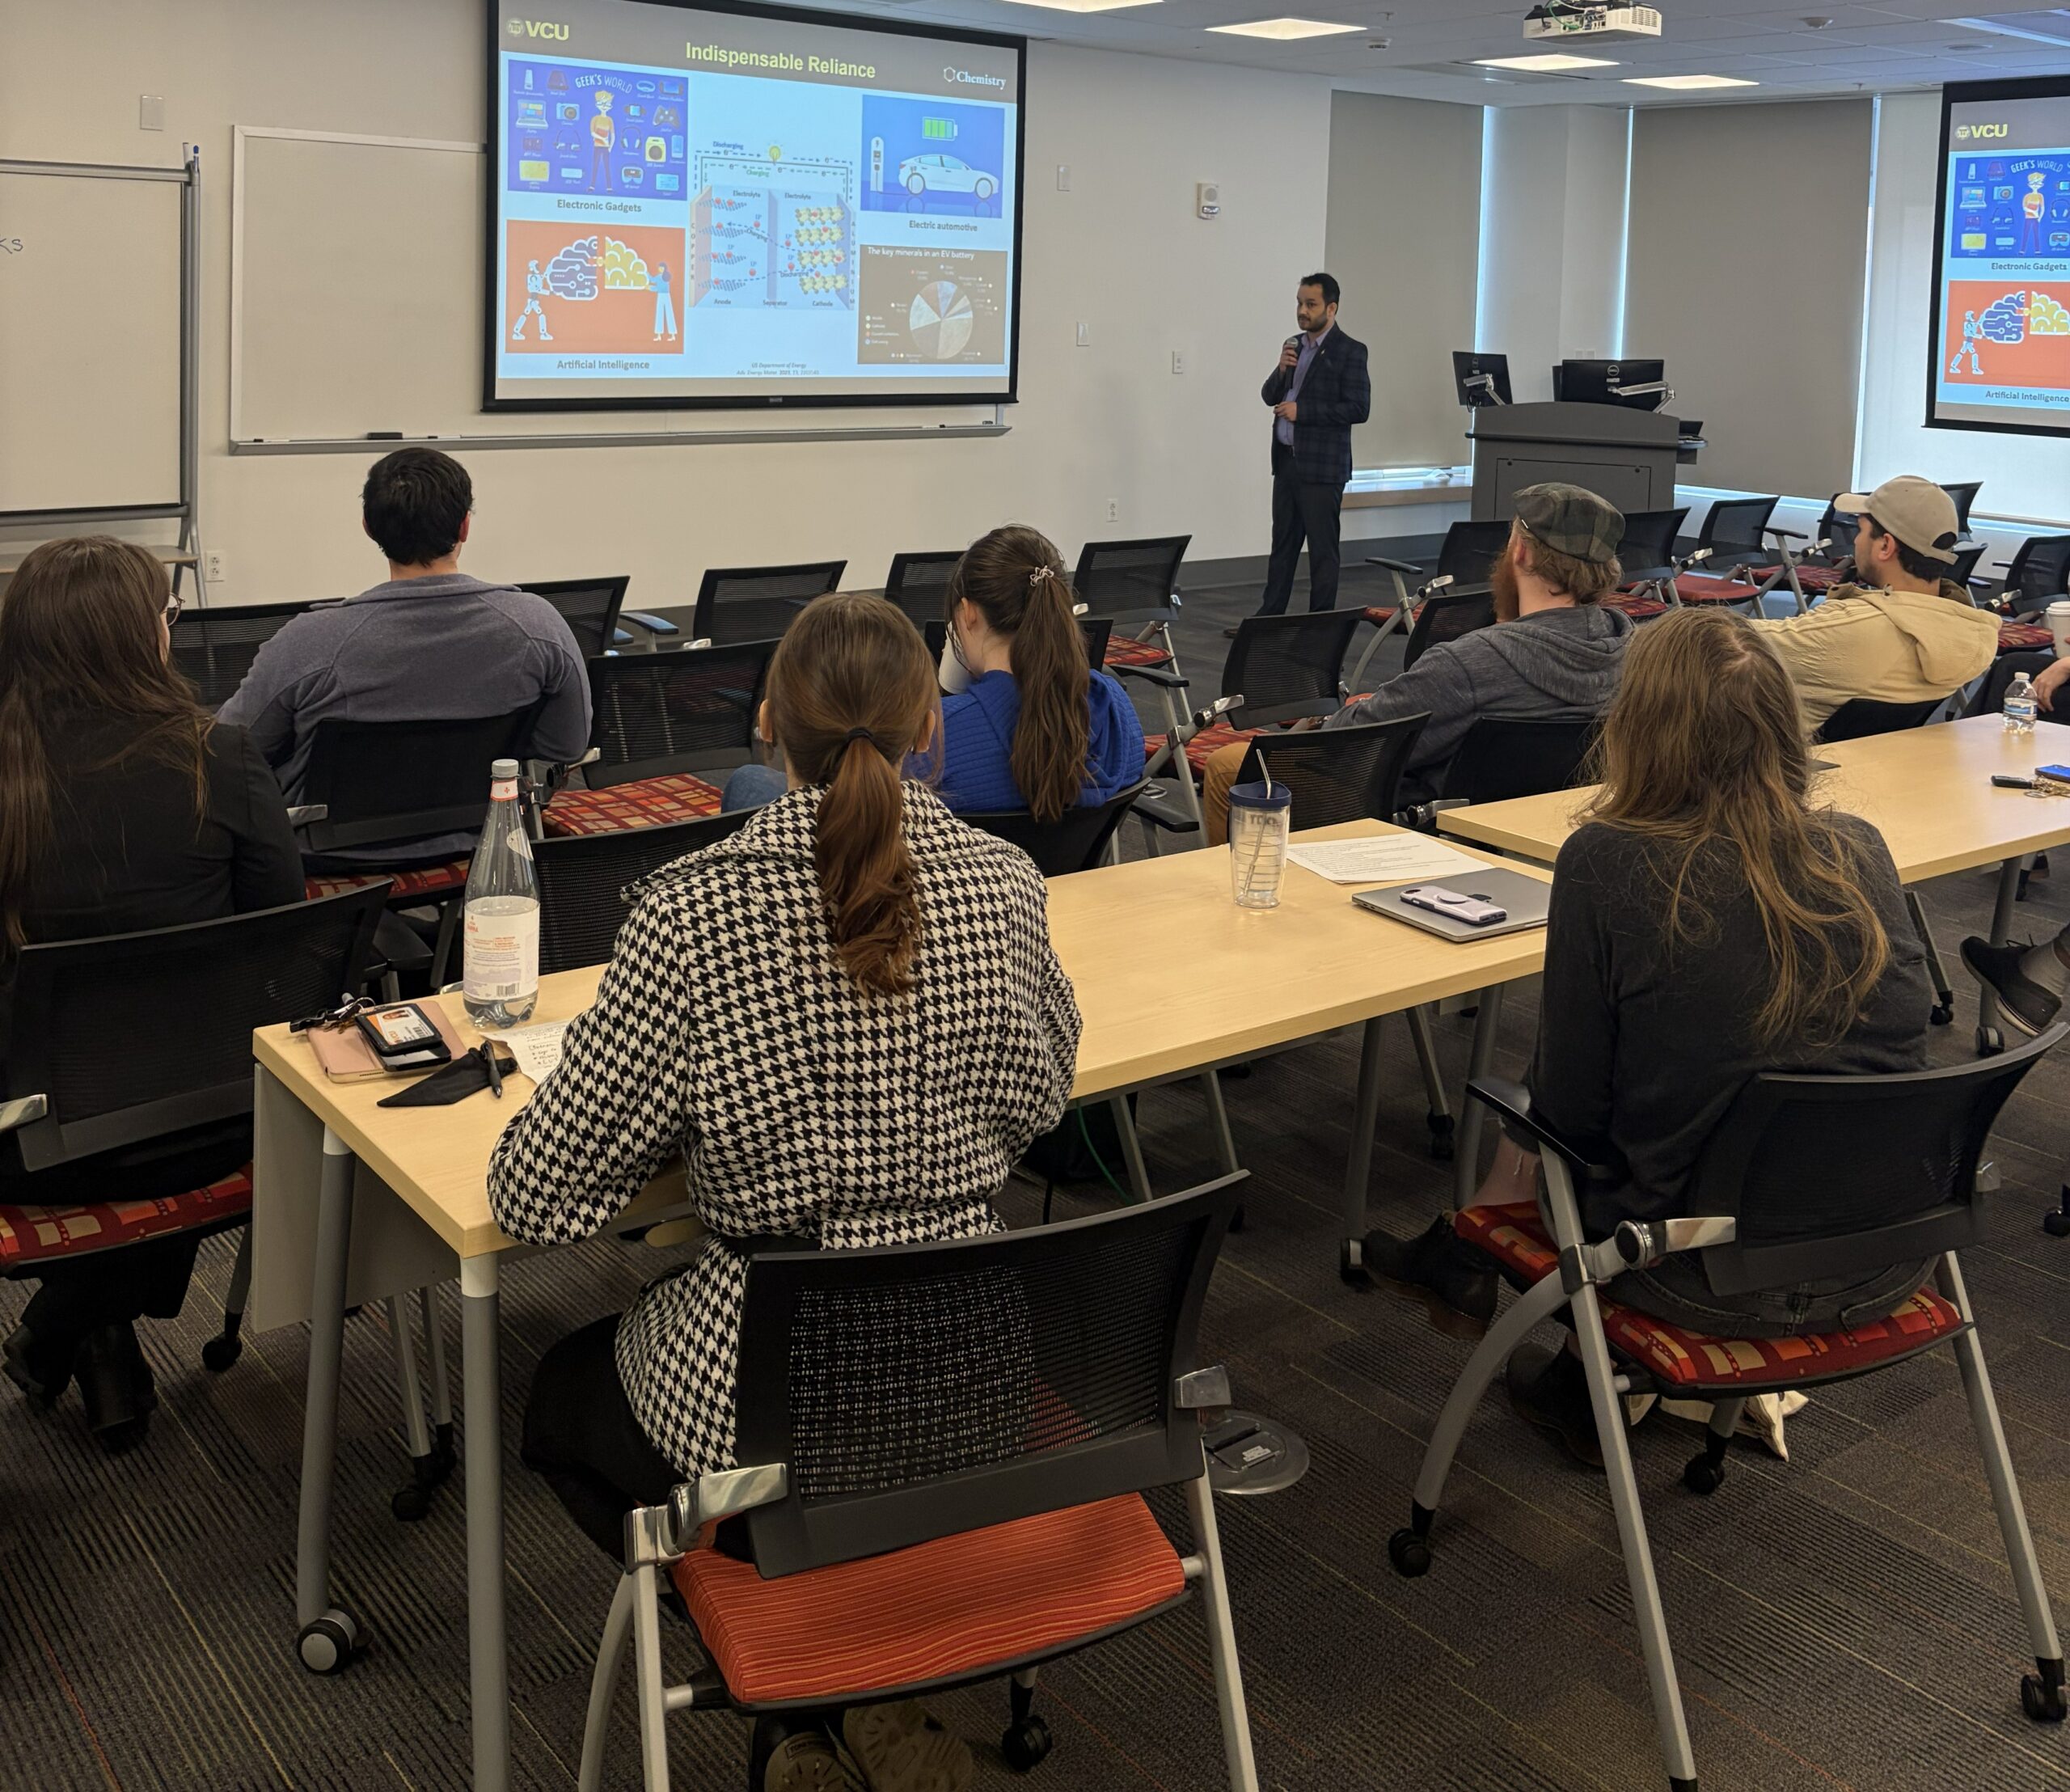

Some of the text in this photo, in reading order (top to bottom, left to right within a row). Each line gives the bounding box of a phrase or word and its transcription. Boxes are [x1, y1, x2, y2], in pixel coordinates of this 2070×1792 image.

[526, 20, 569, 40] VCU
[686, 42, 876, 78] Indispensable Reliance
[575, 74, 632, 94] GEEK'S WORLD
[957, 70, 1007, 90] Chemistry
[1971, 124, 2009, 138] VCU
[712, 141, 744, 150] Discharging
[2010, 159, 2064, 174] GEEK'S WORLD
[746, 169, 770, 178] Charging
[733, 190, 761, 199] Electrolyte
[784, 192, 811, 201] Electrolyte
[557, 199, 642, 213] Electronic Gadgets
[909, 220, 978, 232] Electric automotive
[868, 247, 880, 255] The
[881, 247, 893, 258] key
[895, 249, 923, 257] minerals
[924, 249, 930, 257] in
[952, 251, 974, 260] battery
[1991, 262, 2067, 272] Electronic Gadgets
[557, 360, 649, 370] Artificial Intelligence
[1986, 390, 2070, 403] Artificial Intelligence
